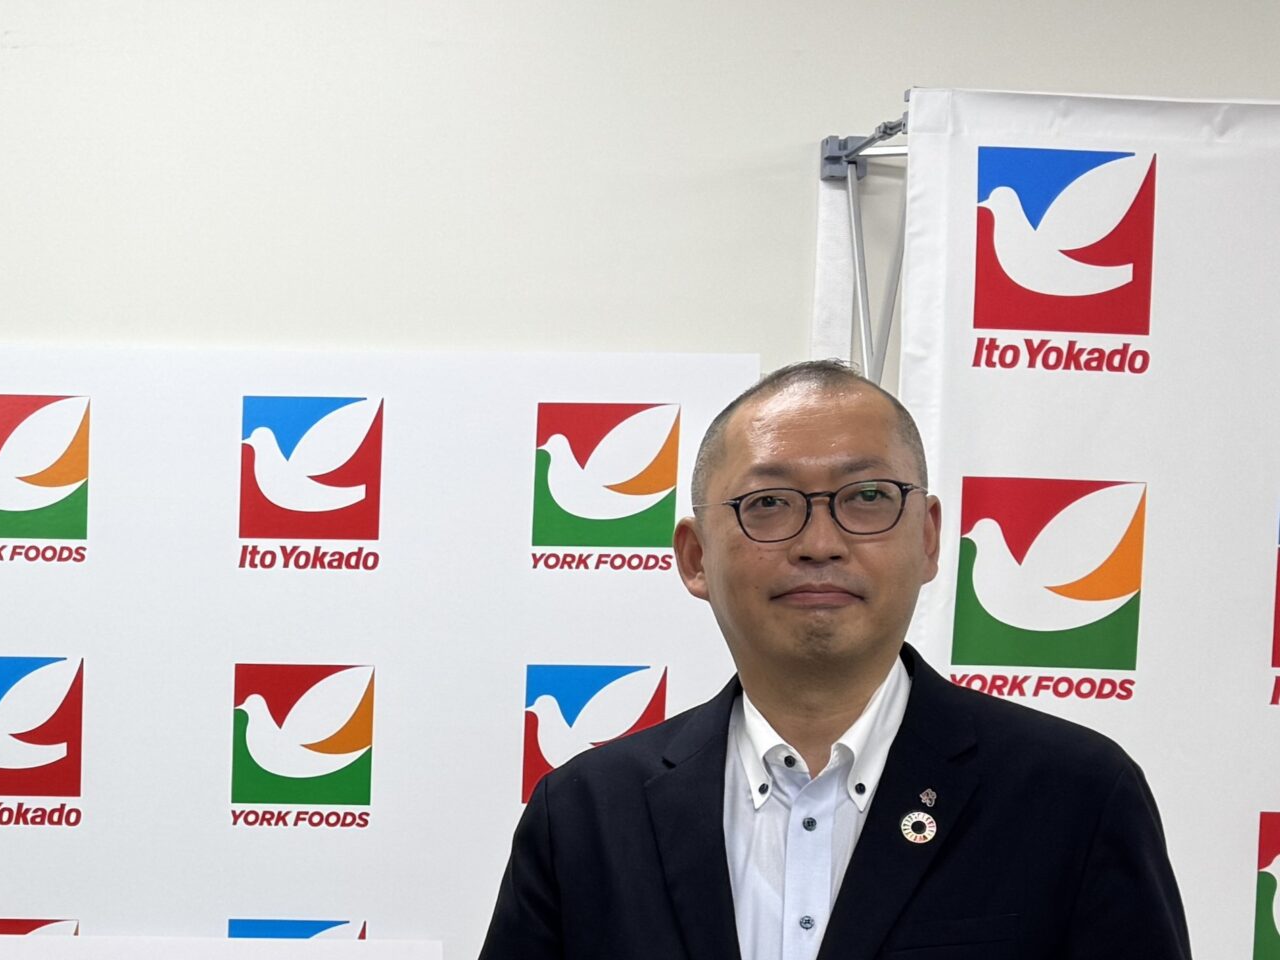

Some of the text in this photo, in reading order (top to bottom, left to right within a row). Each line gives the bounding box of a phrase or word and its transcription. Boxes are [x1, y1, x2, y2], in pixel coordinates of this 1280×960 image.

[972, 337, 1151, 374] Ito Yokado
[9, 544, 86, 563] FOODS
[239, 545, 380, 571] Ito Yokado
[531, 553, 673, 571] YORK FOODS
[1032, 675, 1136, 701] FOODS
[231, 810, 369, 829] YORK FOODS
